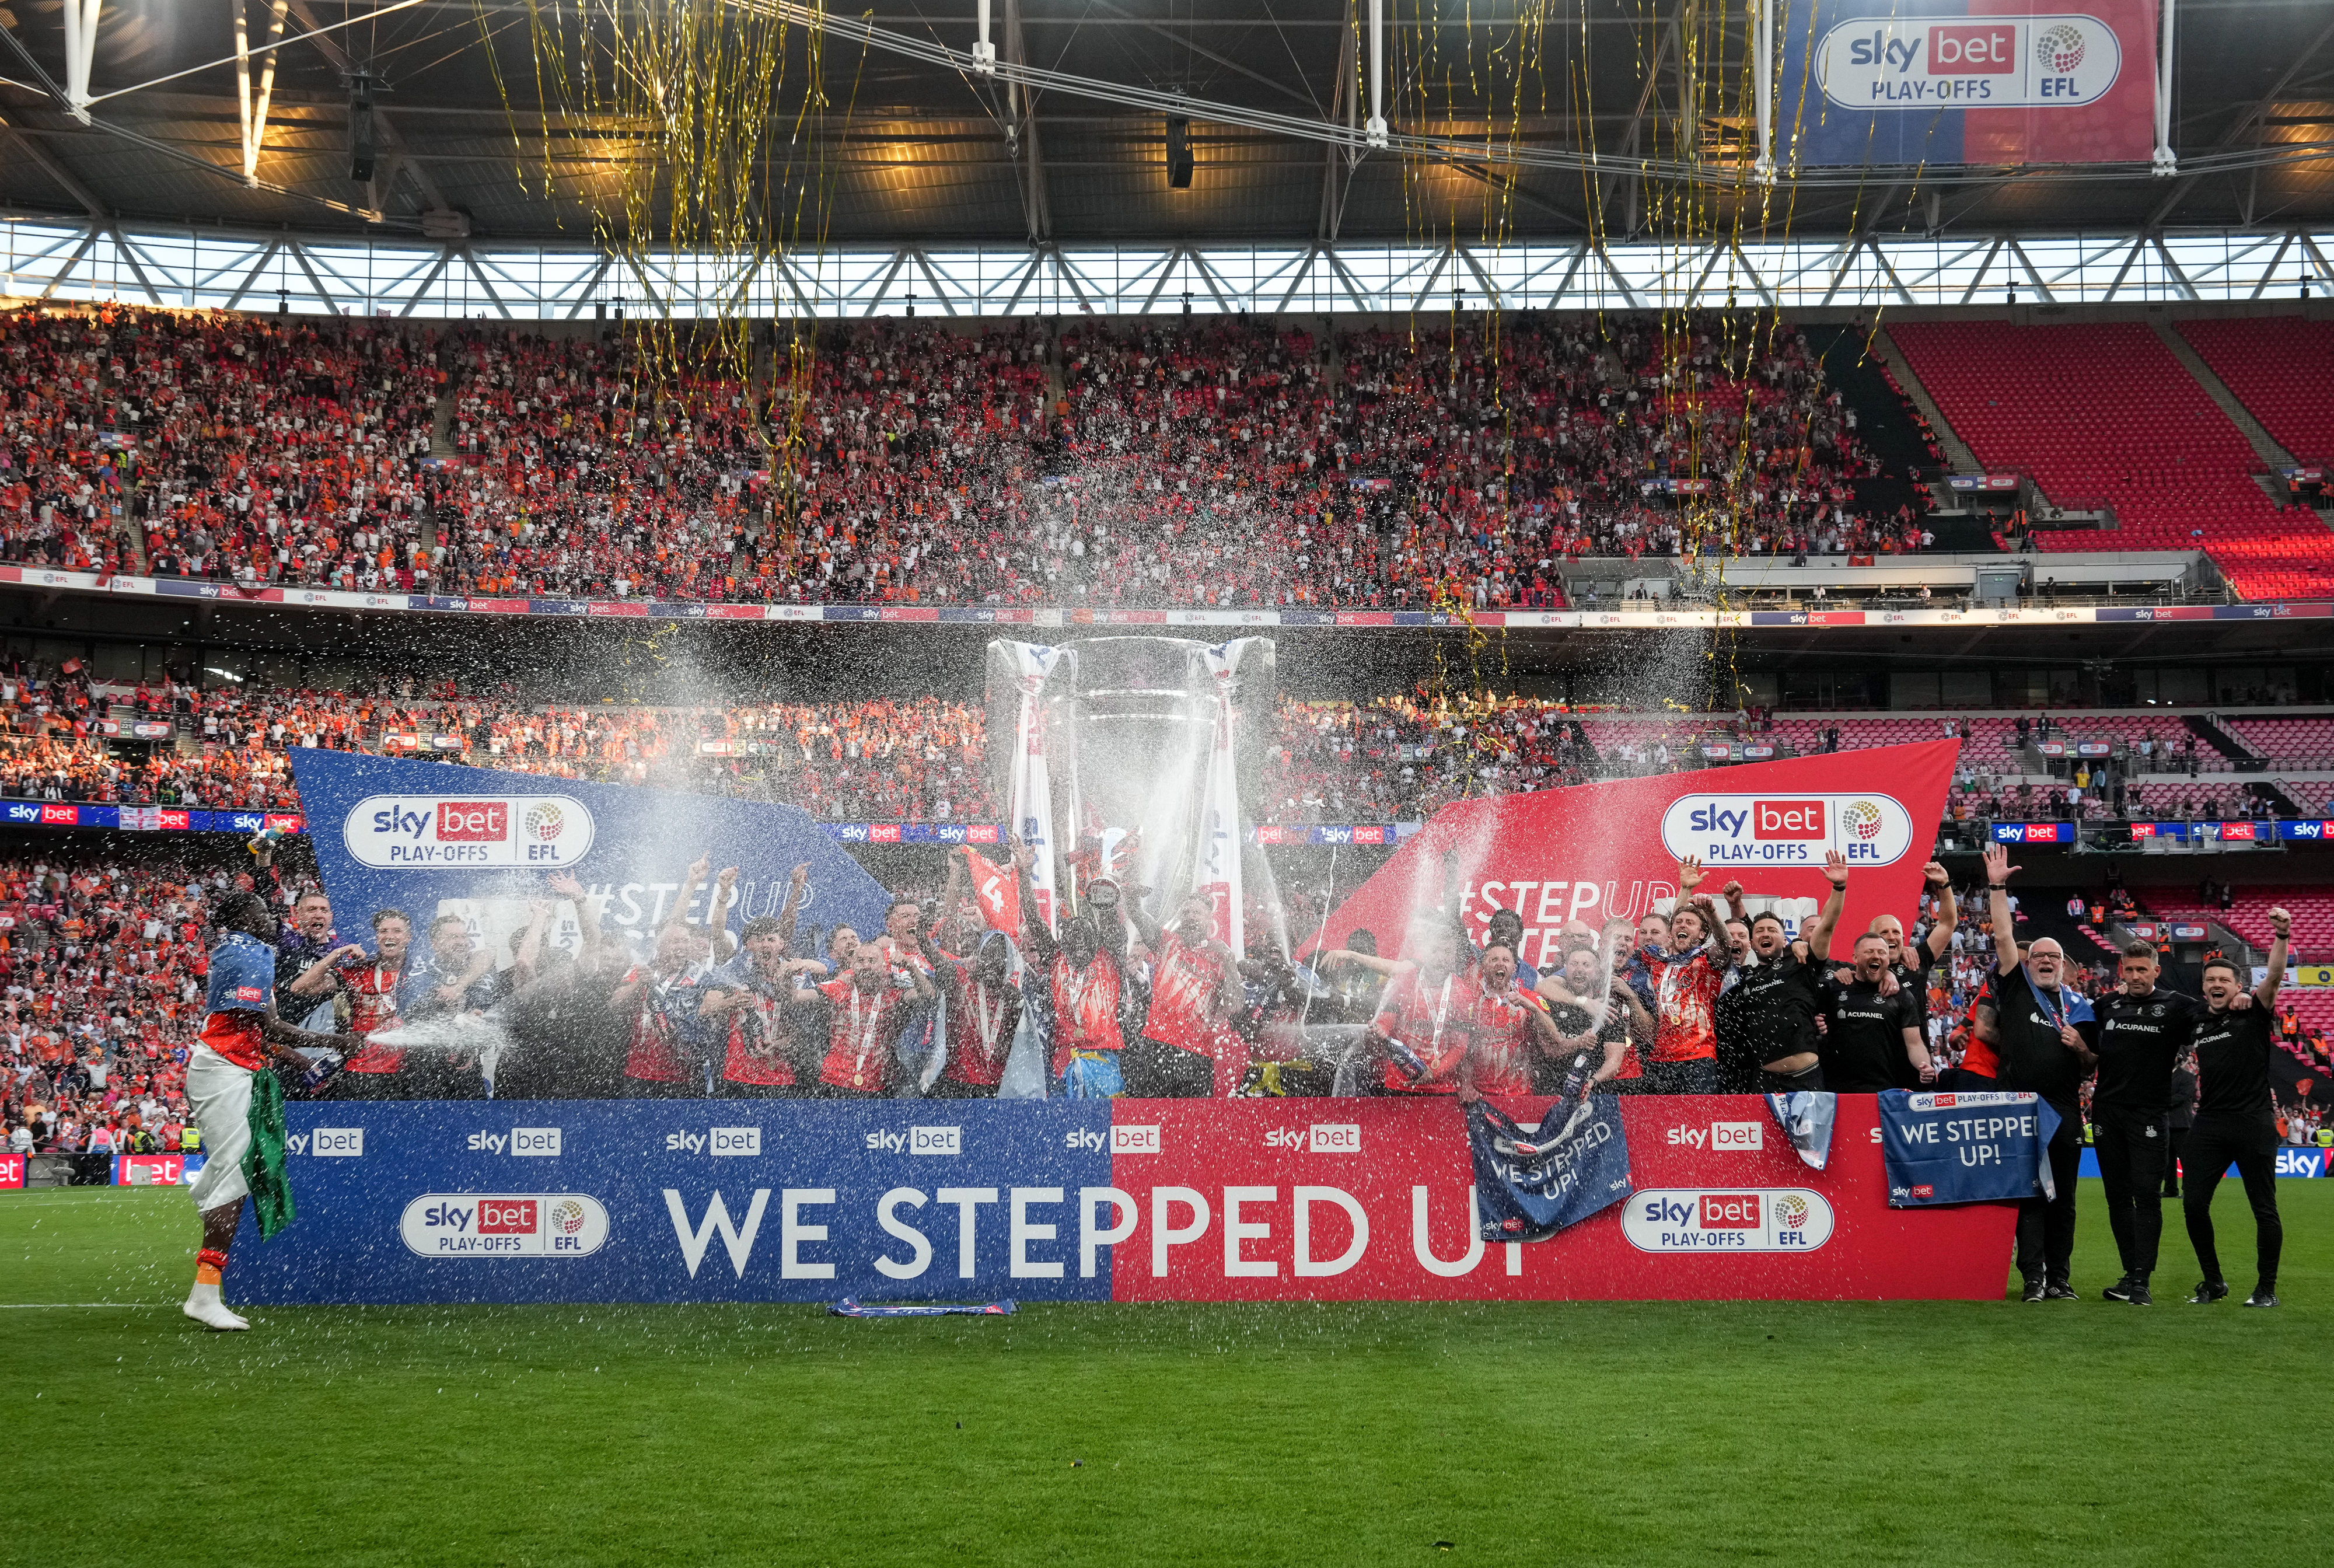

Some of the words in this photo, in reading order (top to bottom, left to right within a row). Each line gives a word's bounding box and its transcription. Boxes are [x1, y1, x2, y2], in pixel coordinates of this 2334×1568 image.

[1851, 30, 1921, 73] sky
[1937, 31, 2006, 63] bet
[1872, 79, 1991, 100] PLAY-OFFS
[2041, 78, 2079, 96] EFL
[200, 586, 219, 597] sky
[222, 587, 240, 597] bet
[450, 600, 468, 610] sky
[471, 600, 488, 609] bet
[570, 603, 588, 614] sky
[591, 605, 607, 613] bet
[687, 606, 705, 617] sky
[708, 607, 725, 616] bet
[2253, 607, 2271, 617] sky
[2274, 607, 2291, 616] bet
[863, 607, 880, 618] sky
[883, 609, 899, 618] bet
[978, 610, 995, 621] sky
[998, 610, 1014, 620] bet
[1112, 612, 1128, 621] bet
[1319, 612, 1336, 622] sky
[1338, 613, 1355, 622] bet
[1432, 614, 1449, 624] sky
[1790, 614, 1807, 624] sky
[1810, 614, 1826, 623] bet
[2136, 610, 2153, 620] sky
[2156, 610, 2172, 618] bet
[9, 805, 40, 822] sky
[45, 807, 74, 820] bet
[1690, 804, 1748, 837] sky
[1762, 805, 1818, 830] bet
[235, 815, 263, 828] sky
[373, 805, 432, 839] sky
[444, 806, 500, 832] bet
[842, 826, 867, 841] sky
[872, 827, 897, 838] bet
[940, 826, 965, 841] sky
[970, 828, 994, 839] bet
[1326, 828, 1351, 842] sky
[1356, 829, 1379, 840] bet
[1998, 826, 2024, 840] sky
[2028, 827, 2053, 837] bet
[2294, 822, 2320, 837] sky
[391, 846, 488, 861] PLAY-OFFS
[528, 845, 560, 860] EFL
[1710, 844, 1807, 860] PLAY-OFFS
[1849, 844, 1879, 858] EFL
[982, 875, 1004, 913] 4
[239, 987, 259, 999] bet
[1751, 979, 1784, 993] ACUPANEL
[1847, 1011, 1884, 1019] ACUPANEL
[2115, 1023, 2161, 1033] ACUPANEL
[2199, 1032, 2232, 1045] ACUPANEL
[1916, 1097, 1933, 1107] sky
[1937, 1095, 1954, 1105] bet
[1958, 1094, 1999, 1103] PLAY-OFFS
[1066, 1127, 1106, 1152] sky
[1116, 1129, 1155, 1147] bet
[1265, 1126, 1305, 1151] sky
[1316, 1127, 1355, 1146] bet
[1668, 1123, 1707, 1149] sky
[1717, 1124, 1757, 1143] bet
[1901, 1122, 1940, 1145] WE
[285, 1129, 309, 1155] ky
[318, 1131, 358, 1150] bet
[467, 1129, 507, 1154] sky
[517, 1130, 556, 1150] bet
[666, 1129, 706, 1154] sky
[715, 1130, 755, 1149] bet
[866, 1129, 906, 1154] sky
[916, 1129, 955, 1148] bet
[1518, 1144, 1536, 1153] bet
[1529, 1122, 1610, 1181] STEPPED
[1959, 1144, 2001, 1167] UP!
[2275, 1150, 2320, 1178] sky
[1543, 1169, 1579, 1200] UP!
[1609, 1178, 1626, 1191] sky
[1892, 1186, 1910, 1197] sky
[1914, 1186, 1931, 1195] bet
[425, 1203, 473, 1232] sky
[484, 1203, 531, 1226] bet
[1645, 1197, 1694, 1226] sky
[1706, 1198, 1753, 1221] bet
[662, 1188, 836, 1280] WE
[873, 1185, 1369, 1280] STEPPED
[1484, 1221, 1502, 1231] sky
[1505, 1220, 1522, 1230] bet
[439, 1238, 521, 1251] PLAY-OFFS
[555, 1237, 581, 1250] EFL
[1662, 1232, 1745, 1246] PLAY-OFFS
[1780, 1232, 1807, 1245] EFL
